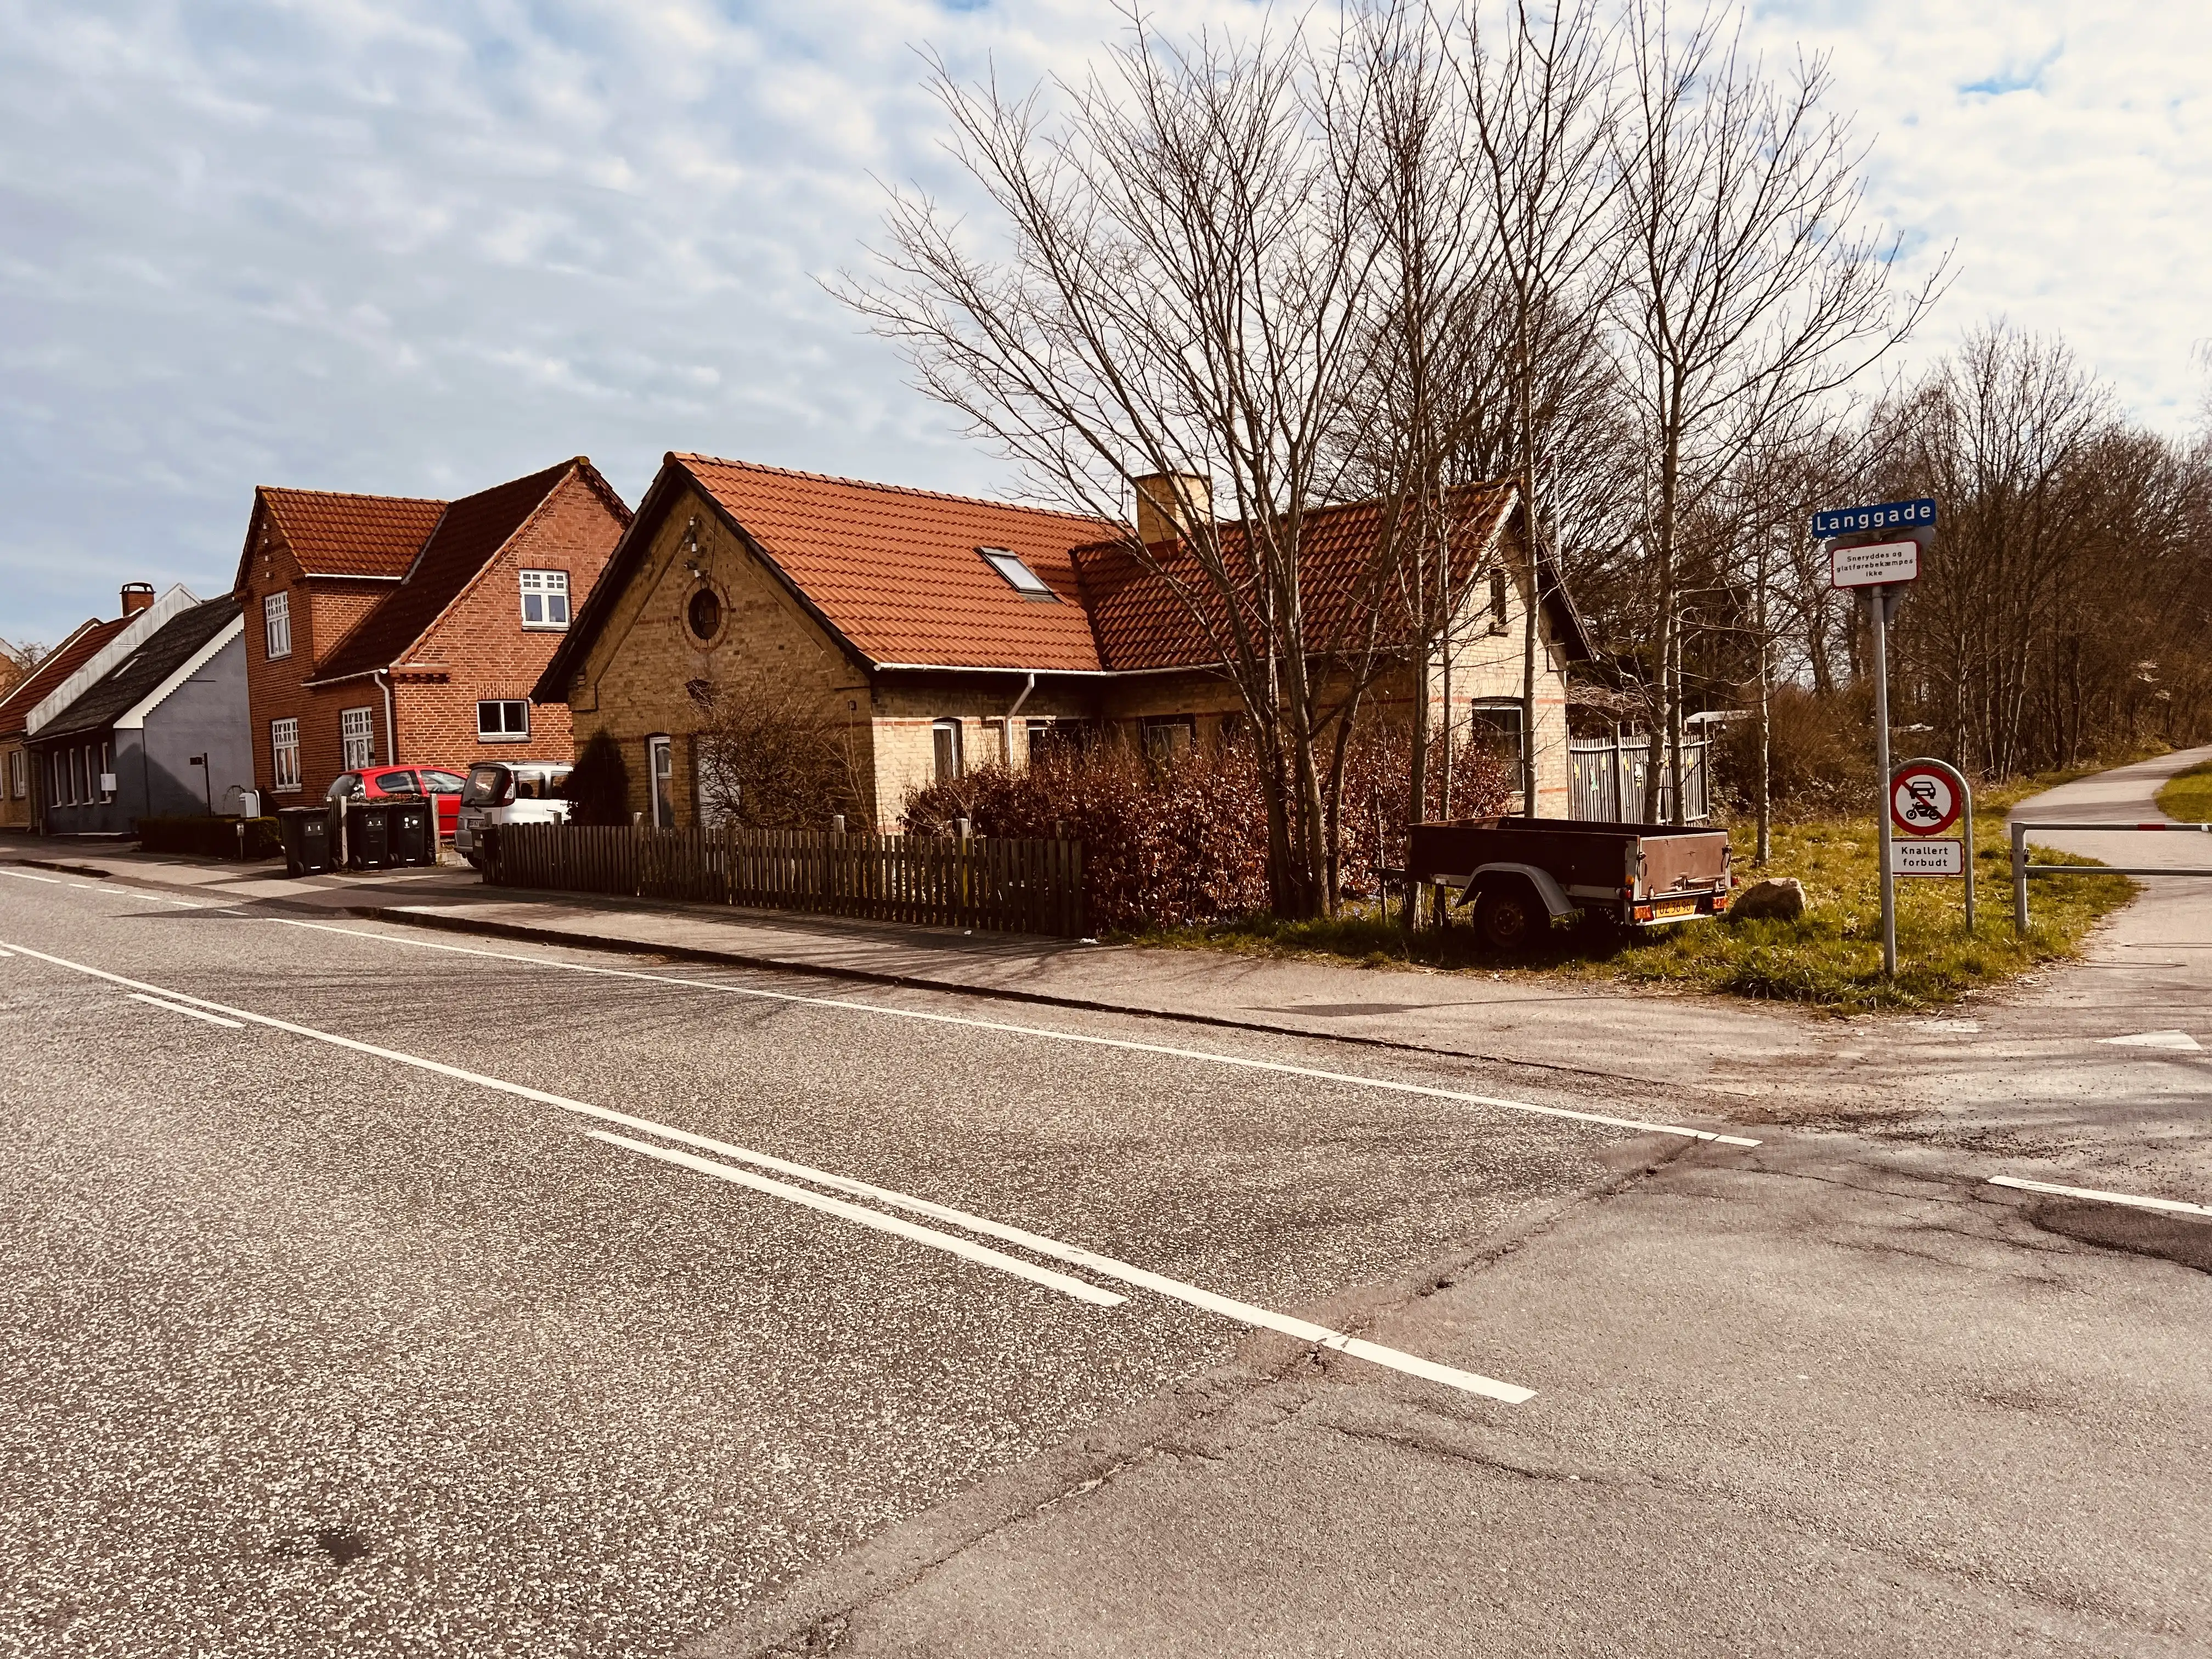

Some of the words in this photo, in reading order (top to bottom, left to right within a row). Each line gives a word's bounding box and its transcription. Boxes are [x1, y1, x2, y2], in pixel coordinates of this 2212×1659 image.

[1817, 504, 1931, 531] Langgade
[1847, 553, 1889, 562] Sneryddes
[1836, 558, 1914, 573] glatførebekæmpes
[1901, 847, 1948, 855] Knallert
[1660, 902, 1669, 915] UZ
